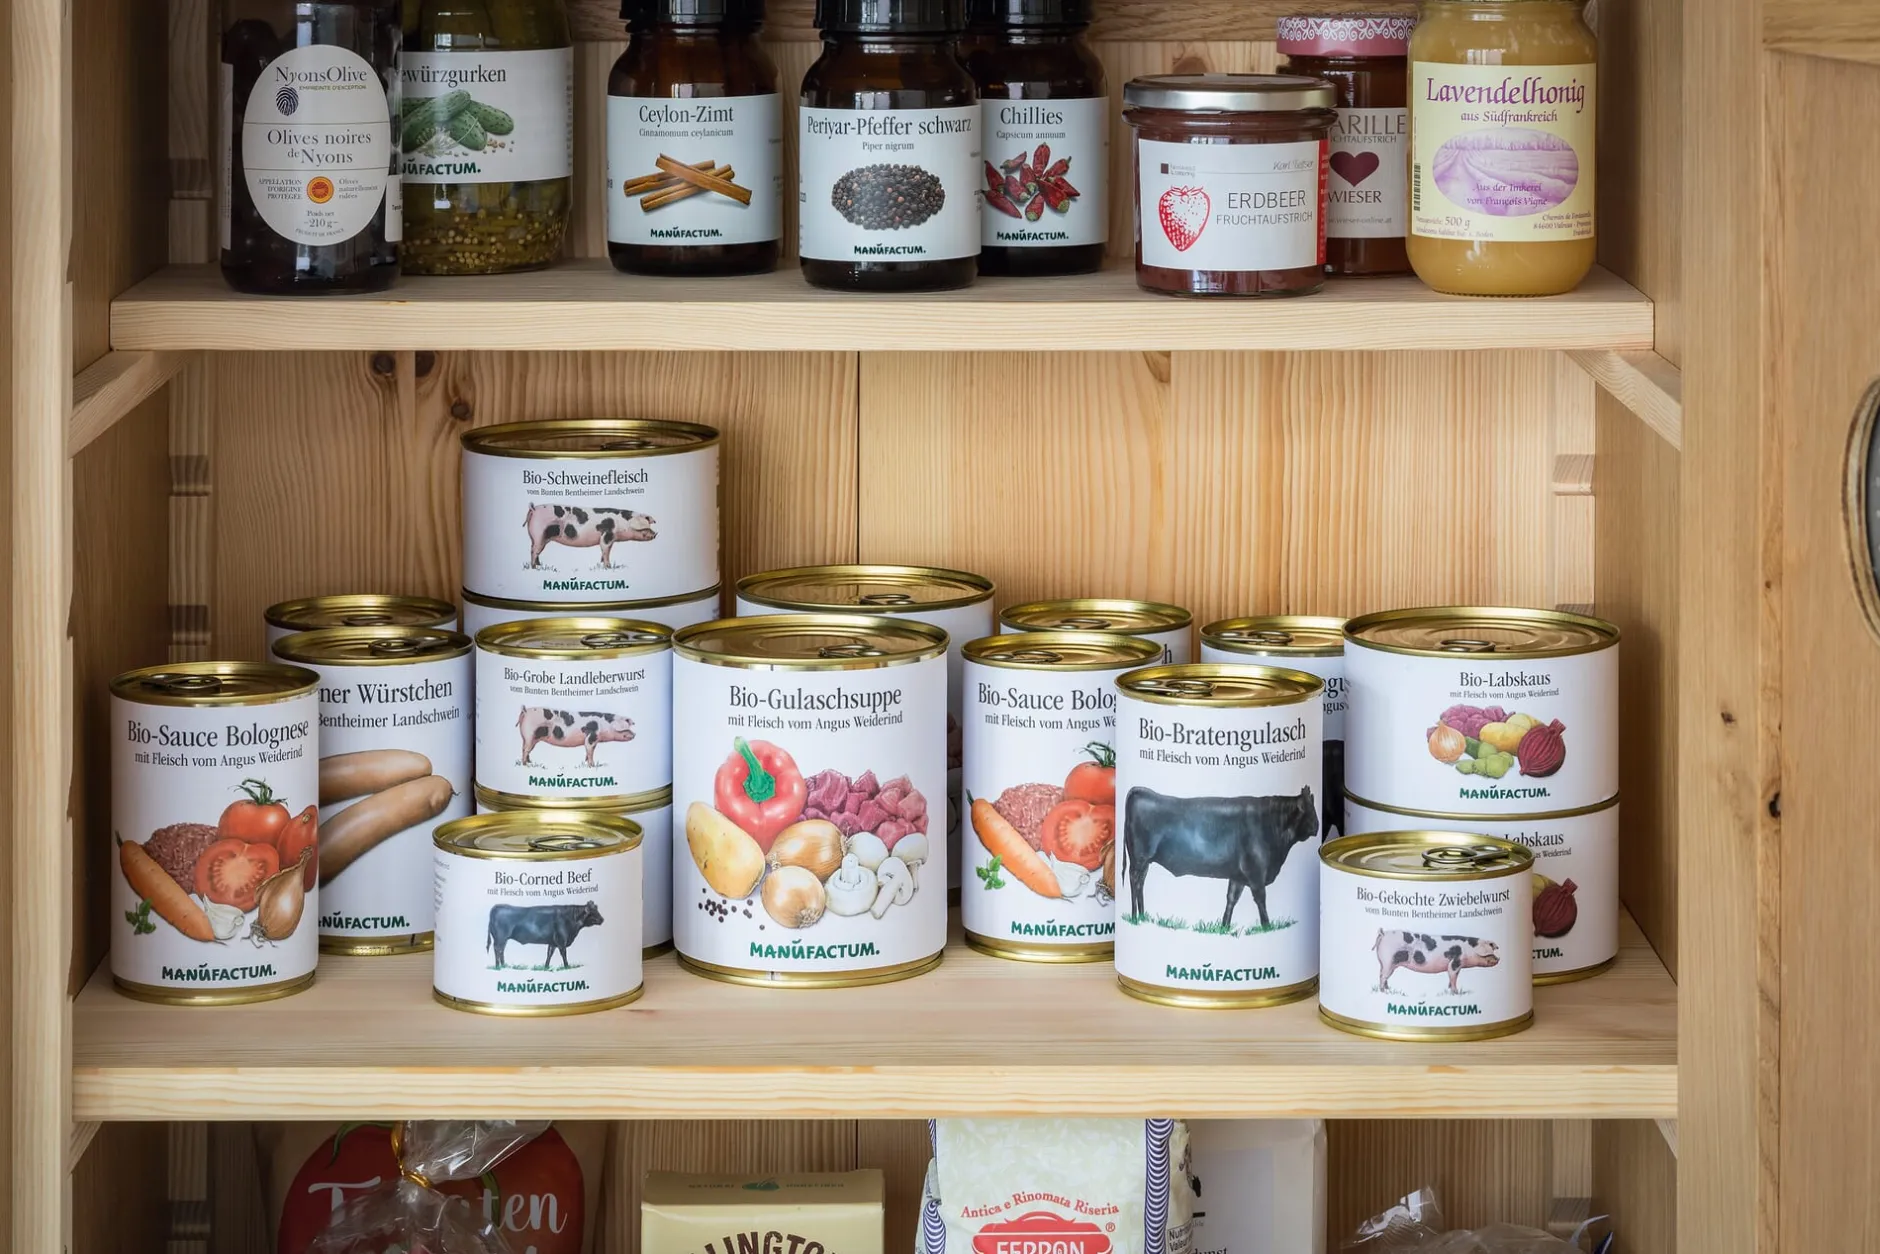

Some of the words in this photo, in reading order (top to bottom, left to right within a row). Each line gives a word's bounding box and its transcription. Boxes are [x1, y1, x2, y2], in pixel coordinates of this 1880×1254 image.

[275, 65, 368, 86] NyonsOlive
[399, 64, 507, 88] ewürzgurken
[1426, 76, 1586, 114] Lavendelhonig
[638, 104, 735, 128] Ceylon-Zimt
[1000, 107, 1064, 125] Chillies
[1329, 114, 1407, 135] ARILLE
[1460, 112, 1480, 122] aus
[1482, 109, 1559, 127] Südfrankreich
[267, 129, 320, 146] Olives
[325, 128, 372, 145] noires
[807, 115, 913, 140] Periyar-Pfeffer
[918, 115, 973, 135] schwarz
[996, 130, 1034, 140] Capsicum
[1035, 131, 1067, 139] annuum
[862, 141, 884, 153] Piper
[885, 142, 915, 152] nigrum
[287, 148, 300, 159] de
[301, 148, 354, 167] Nyons
[1228, 189, 1307, 209] ERDBEER
[1328, 190, 1383, 204] WIESER
[1216, 211, 1313, 226] FRUCHTAUFSTRICH
[1444, 216, 1464, 227] 500
[522, 468, 649, 486] Bio-Schweinefleisch
[526, 489, 540, 497] vom
[541, 488, 564, 497] Bunten
[565, 488, 603, 497] Bentheimer
[603, 487, 645, 496] Landschwein
[504, 667, 556, 685] Bio-Grobe
[559, 668, 646, 686] Landleberwurst
[1459, 671, 1552, 687] Bio-Labskaus
[356, 678, 454, 705] Würstchen
[510, 686, 523, 694] vom
[524, 685, 549, 696] Bunten
[551, 687, 594, 697] Bentheimer
[595, 685, 639, 696] Landschwein
[729, 685, 902, 714] Bio-Gulaschsuppe
[978, 682, 1065, 711] Bio-Sauce
[1449, 690, 1462, 698] mit
[1463, 690, 1488, 699] Fleisch
[1505, 691, 1527, 701] Angus
[1528, 687, 1560, 698] Weiderind
[391, 705, 461, 728] Landschwein
[728, 714, 745, 727] mit
[748, 714, 785, 730] Fleisch
[787, 719, 813, 730] vom
[815, 717, 851, 733] Angus
[853, 710, 904, 729] Weiderind
[984, 713, 1000, 725] mit
[1001, 714, 1036, 729] Fleisch
[1038, 719, 1063, 730] vom
[1066, 716, 1101, 732] Angus
[127, 719, 219, 747] Bio-Sauce
[225, 719, 310, 750] Bolognese
[1139, 717, 1307, 752] Bio-Bratengulasch
[134, 751, 151, 764] mit
[151, 751, 189, 767] Fleisch
[192, 755, 218, 767] vom
[220, 753, 257, 769] Angus
[258, 744, 304, 765] Weiderind
[1139, 748, 1155, 761] mit
[1156, 749, 1192, 765] Fleisch
[1195, 755, 1220, 766] vom
[1222, 753, 1259, 769] Angus
[1261, 745, 1307, 764] Weiderind
[494, 870, 563, 886] Bio-Corned
[566, 867, 593, 884] Beef
[487, 887, 499, 895] mit
[500, 887, 524, 897] Fleisch
[525, 889, 541, 897] vom
[542, 887, 565, 899] Angus
[566, 884, 599, 896] Weiderind
[1356, 886, 1436, 906] Bio-Gekochte
[1438, 888, 1511, 907] Zwiebelwurst
[1365, 905, 1380, 915] vom
[1381, 907, 1409, 918] Bunten
[1411, 909, 1458, 919] Bentheimer
[1459, 905, 1503, 918] Landschwein
[960, 1204, 1002, 1218] Antica
[1003, 1200, 1012, 1210] e
[1012, 1191, 1072, 1208] Rinomata
[1074, 1199, 1120, 1216] Riseria
